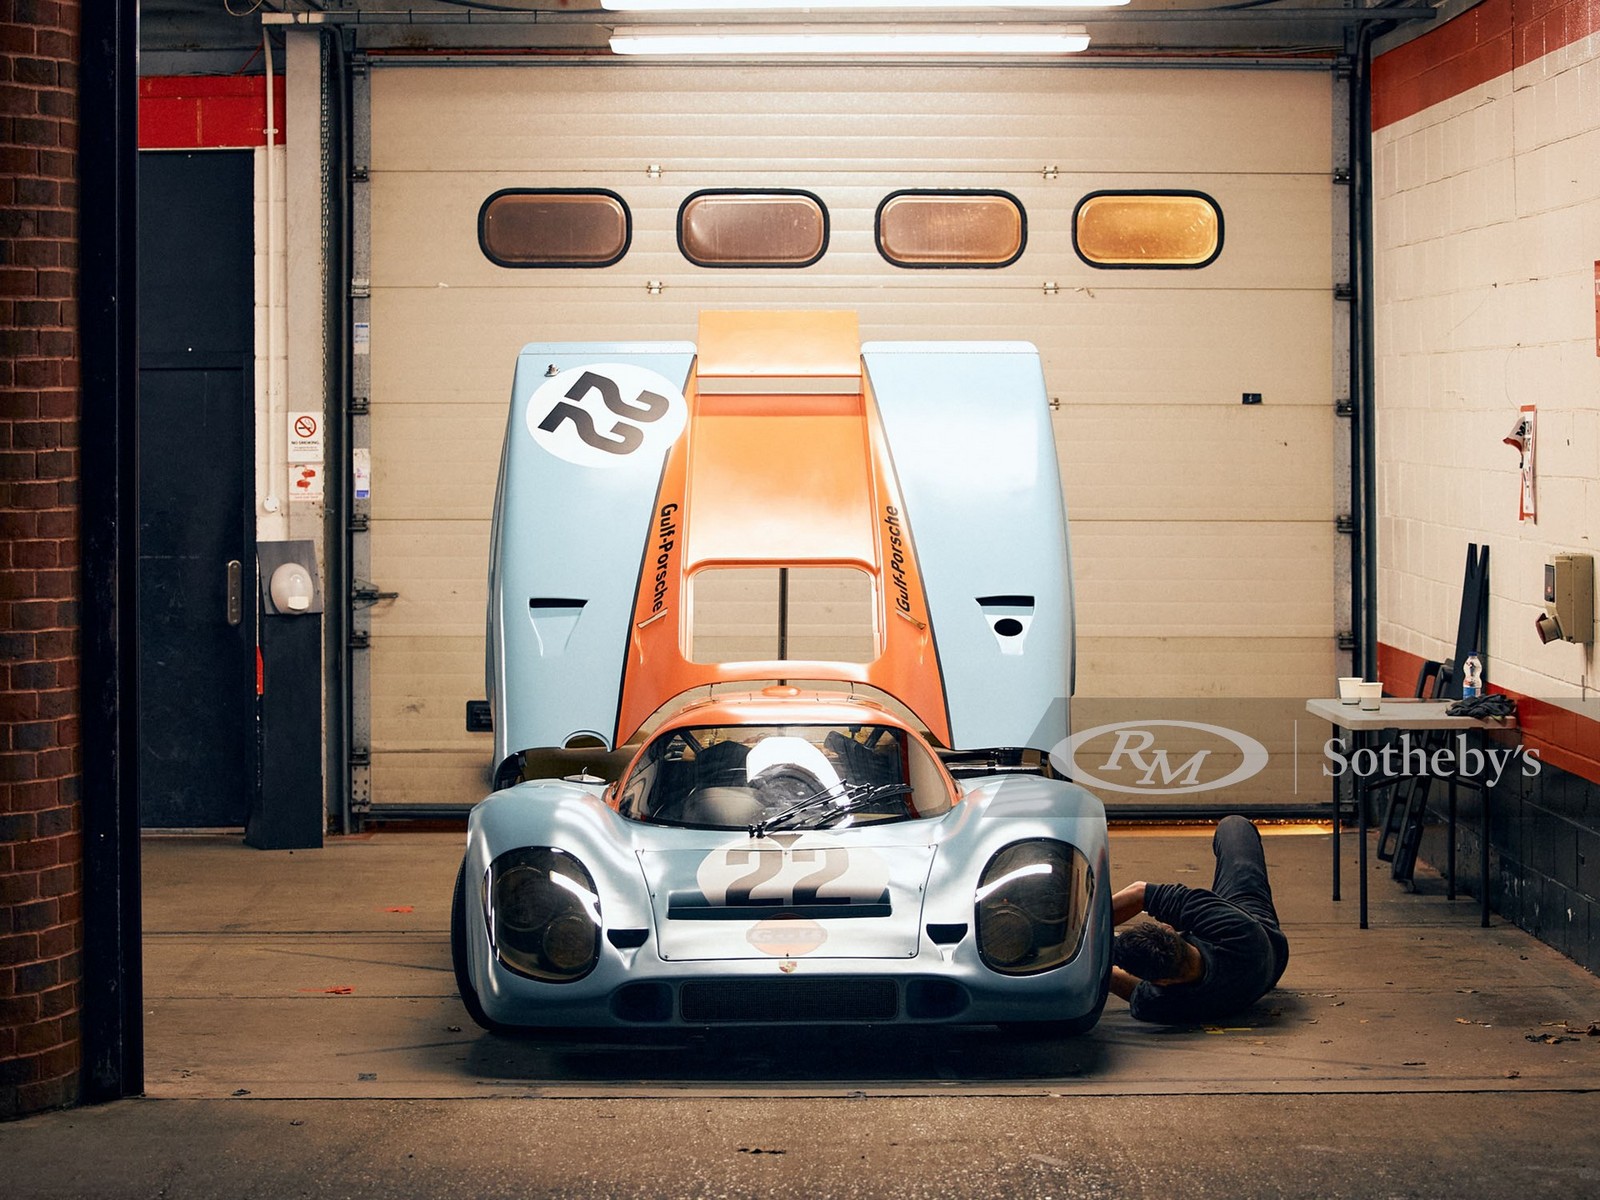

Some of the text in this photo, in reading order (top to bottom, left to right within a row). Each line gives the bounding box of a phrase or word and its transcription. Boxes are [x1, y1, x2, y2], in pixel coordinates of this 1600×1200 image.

[538, 371, 670, 455] 22
[652, 503, 678, 612] Gulf-Porsche
[884, 505, 911, 612] Gulf-Porsche
[725, 843, 851, 906] 22
